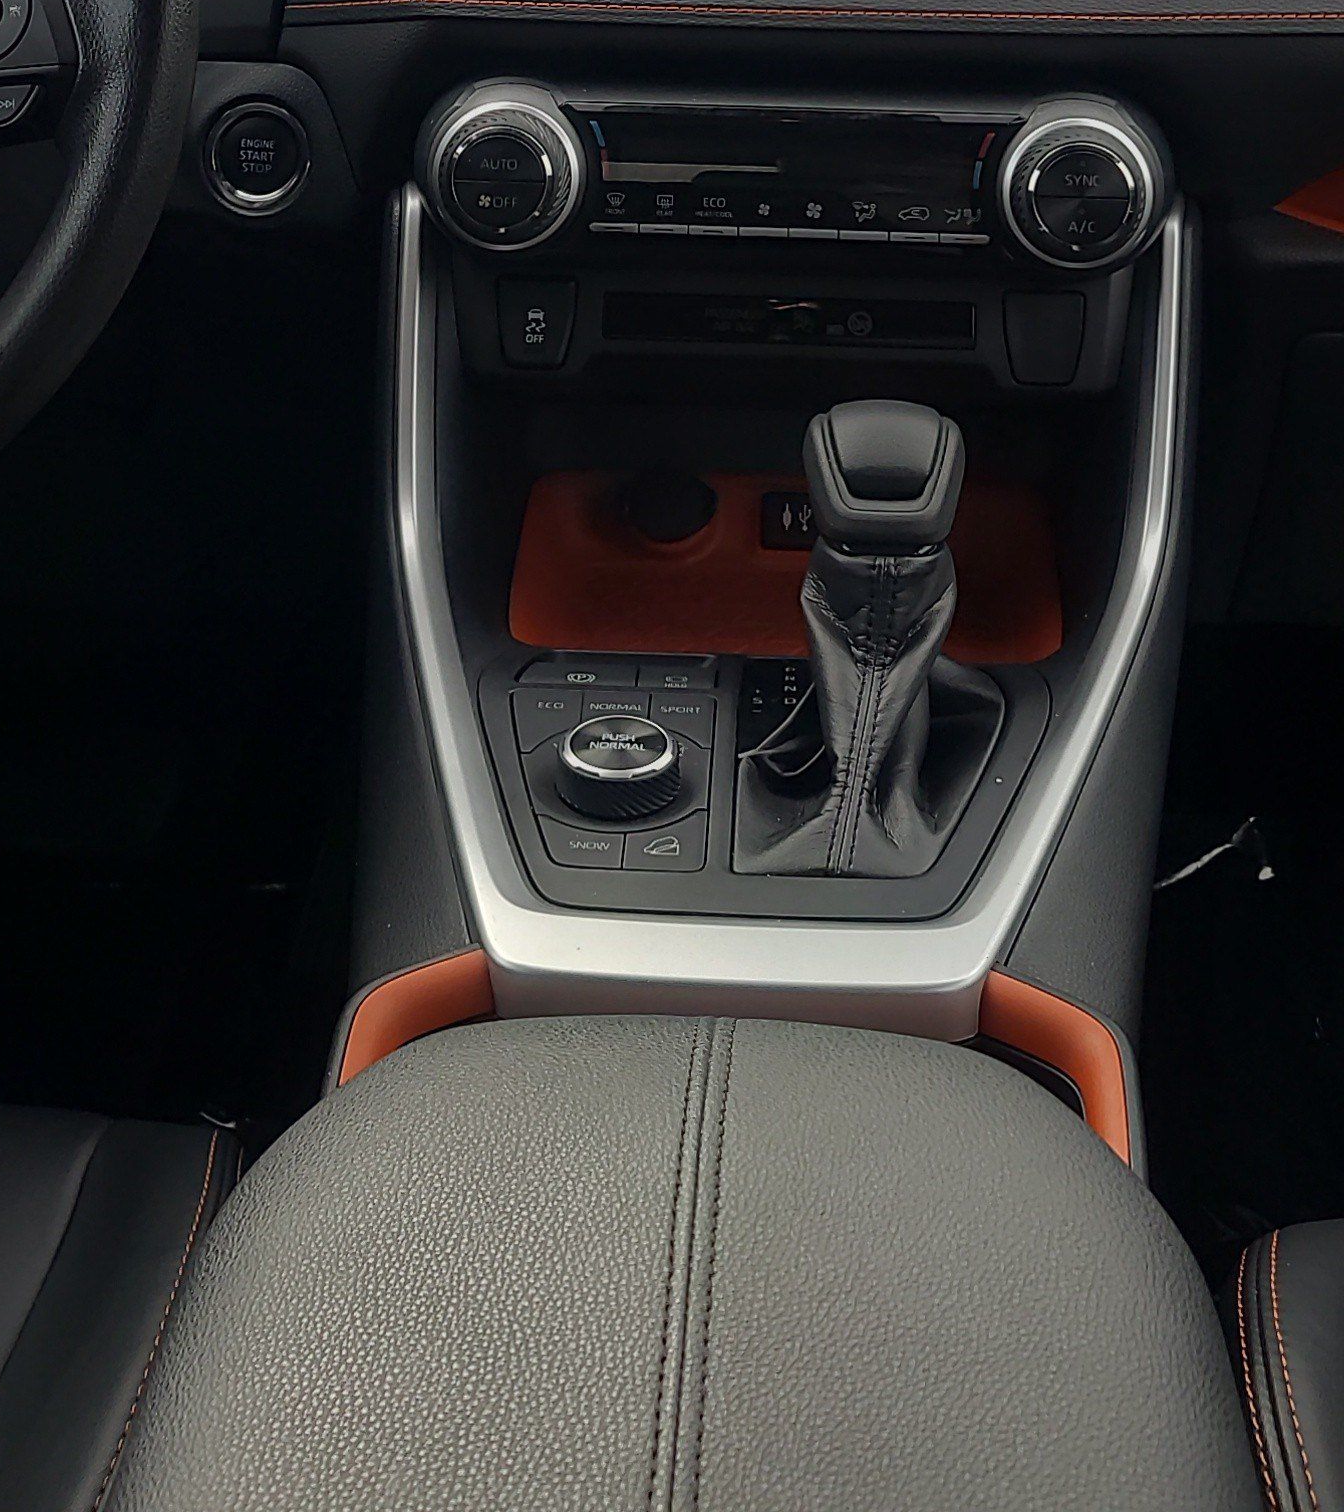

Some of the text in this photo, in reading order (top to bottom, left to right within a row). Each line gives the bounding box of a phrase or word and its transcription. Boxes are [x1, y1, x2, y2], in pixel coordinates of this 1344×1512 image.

[241, 138, 275, 149] ENGINE
[239, 150, 275, 162] START
[242, 162, 272, 173] STOP
[480, 158, 518, 170] AUTO
[1064, 174, 1102, 187] SYNC
[493, 196, 517, 208] OFF
[703, 197, 726, 208] ECO
[1067, 220, 1096, 234] A/C
[526, 333, 545, 344] OFF
[589, 702, 643, 712] NORMAL
[659, 705, 702, 715] SPORT
[601, 733, 636, 742] PUSH
[589, 741, 646, 751] NORMAL
[569, 840, 610, 851] SNOW
